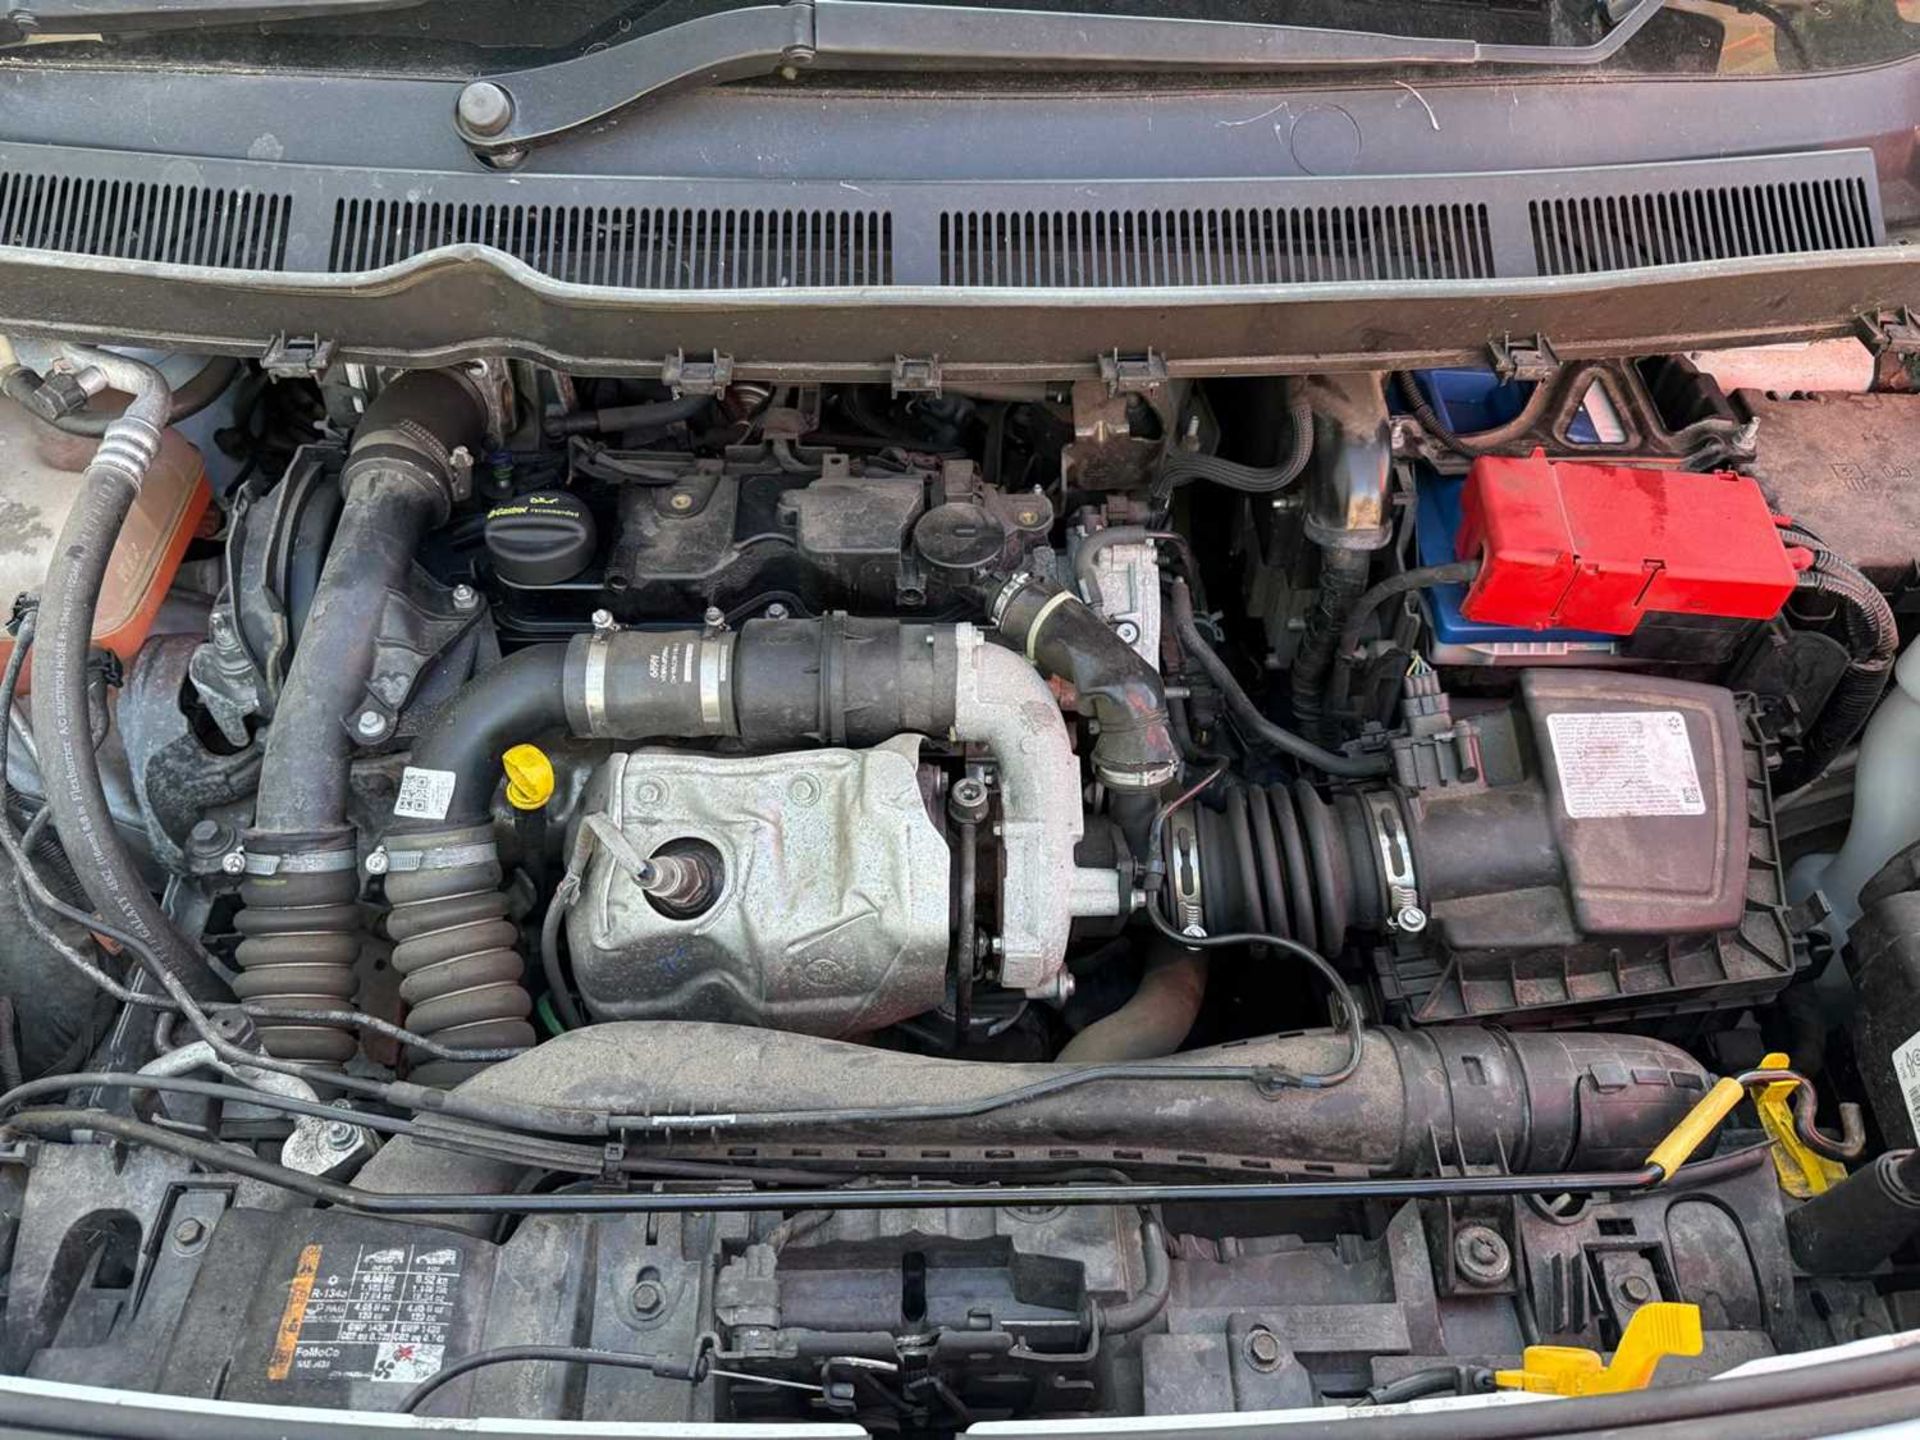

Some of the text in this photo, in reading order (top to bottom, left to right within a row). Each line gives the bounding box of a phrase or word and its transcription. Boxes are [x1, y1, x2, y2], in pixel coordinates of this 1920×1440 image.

[56, 641, 67, 669] HOSE
[55, 669, 67, 717] SUCTION
[295, 1346, 340, 1358] FoMoCo
